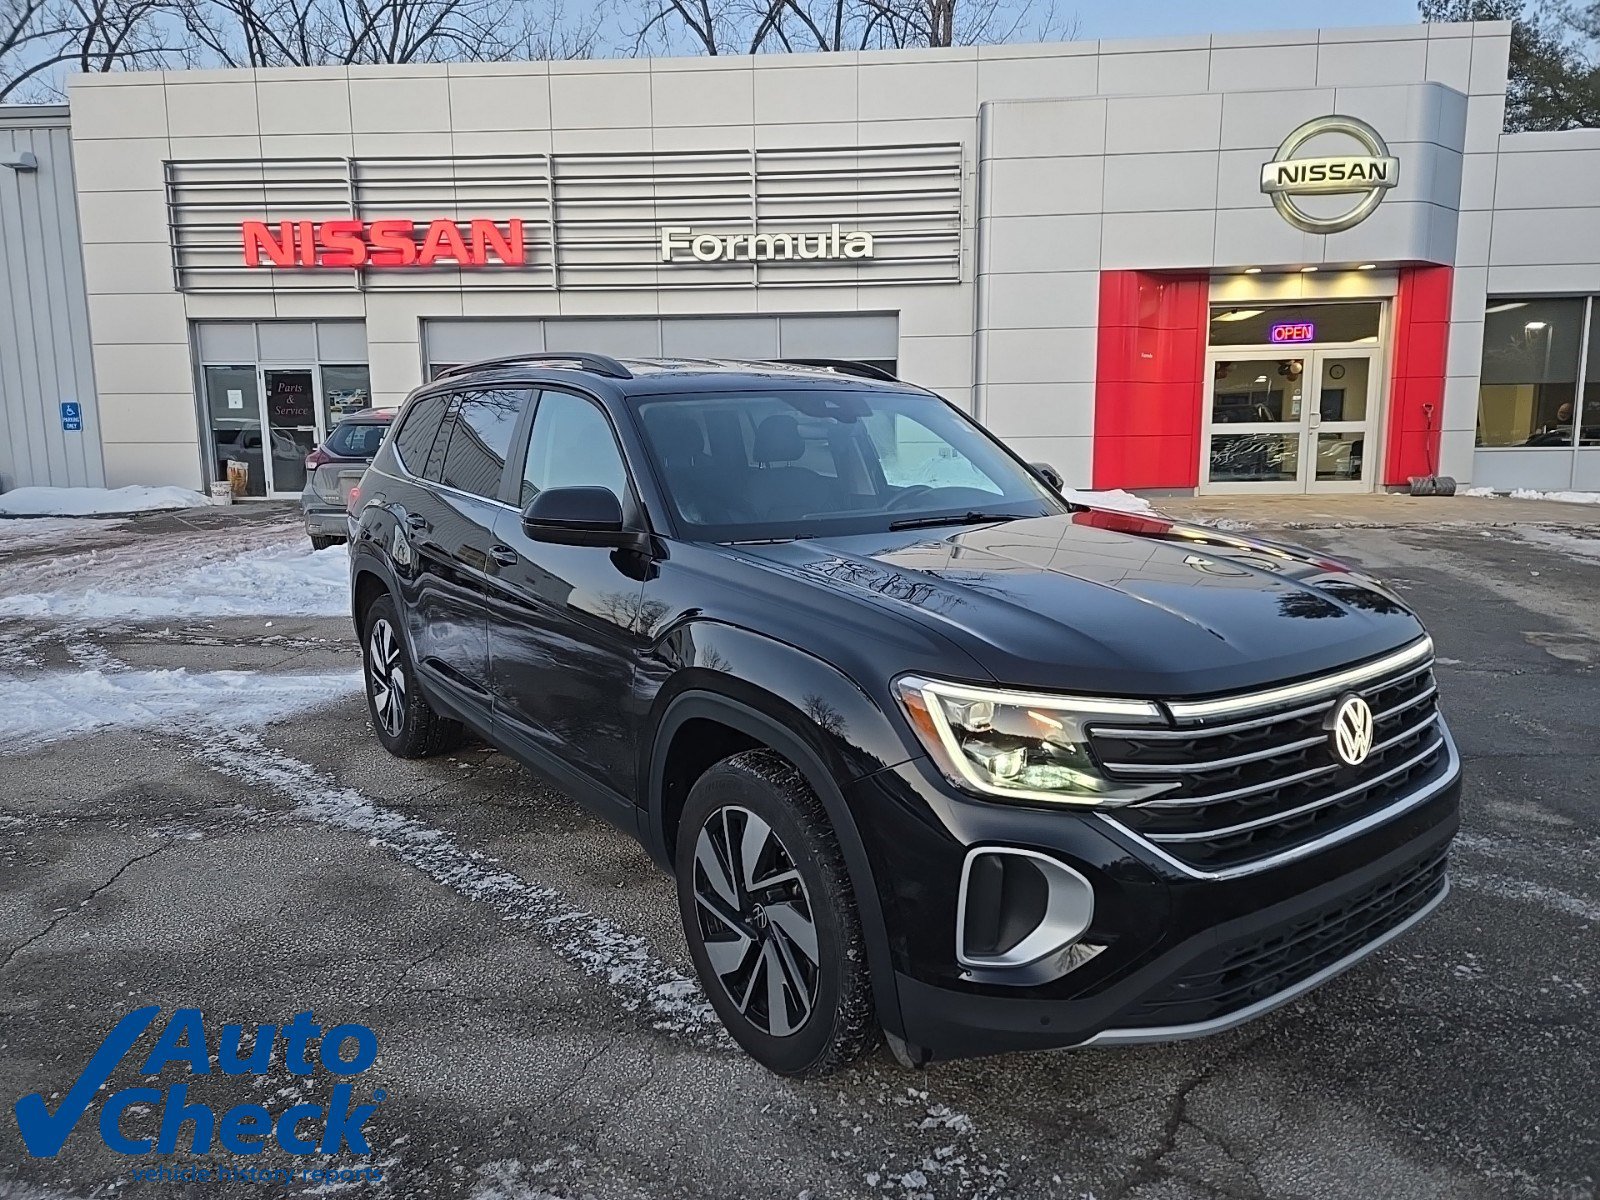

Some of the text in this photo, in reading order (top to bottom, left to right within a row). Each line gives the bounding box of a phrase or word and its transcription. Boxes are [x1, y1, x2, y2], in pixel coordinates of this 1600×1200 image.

[1277, 161, 1388, 185] NISSAN
[242, 219, 526, 267] NISSAN
[661, 223, 875, 261] Formula
[1274, 326, 1312, 341] OPEN
[278, 382, 303, 393] Parts
[286, 394, 295, 404] &
[275, 405, 309, 415] Service
